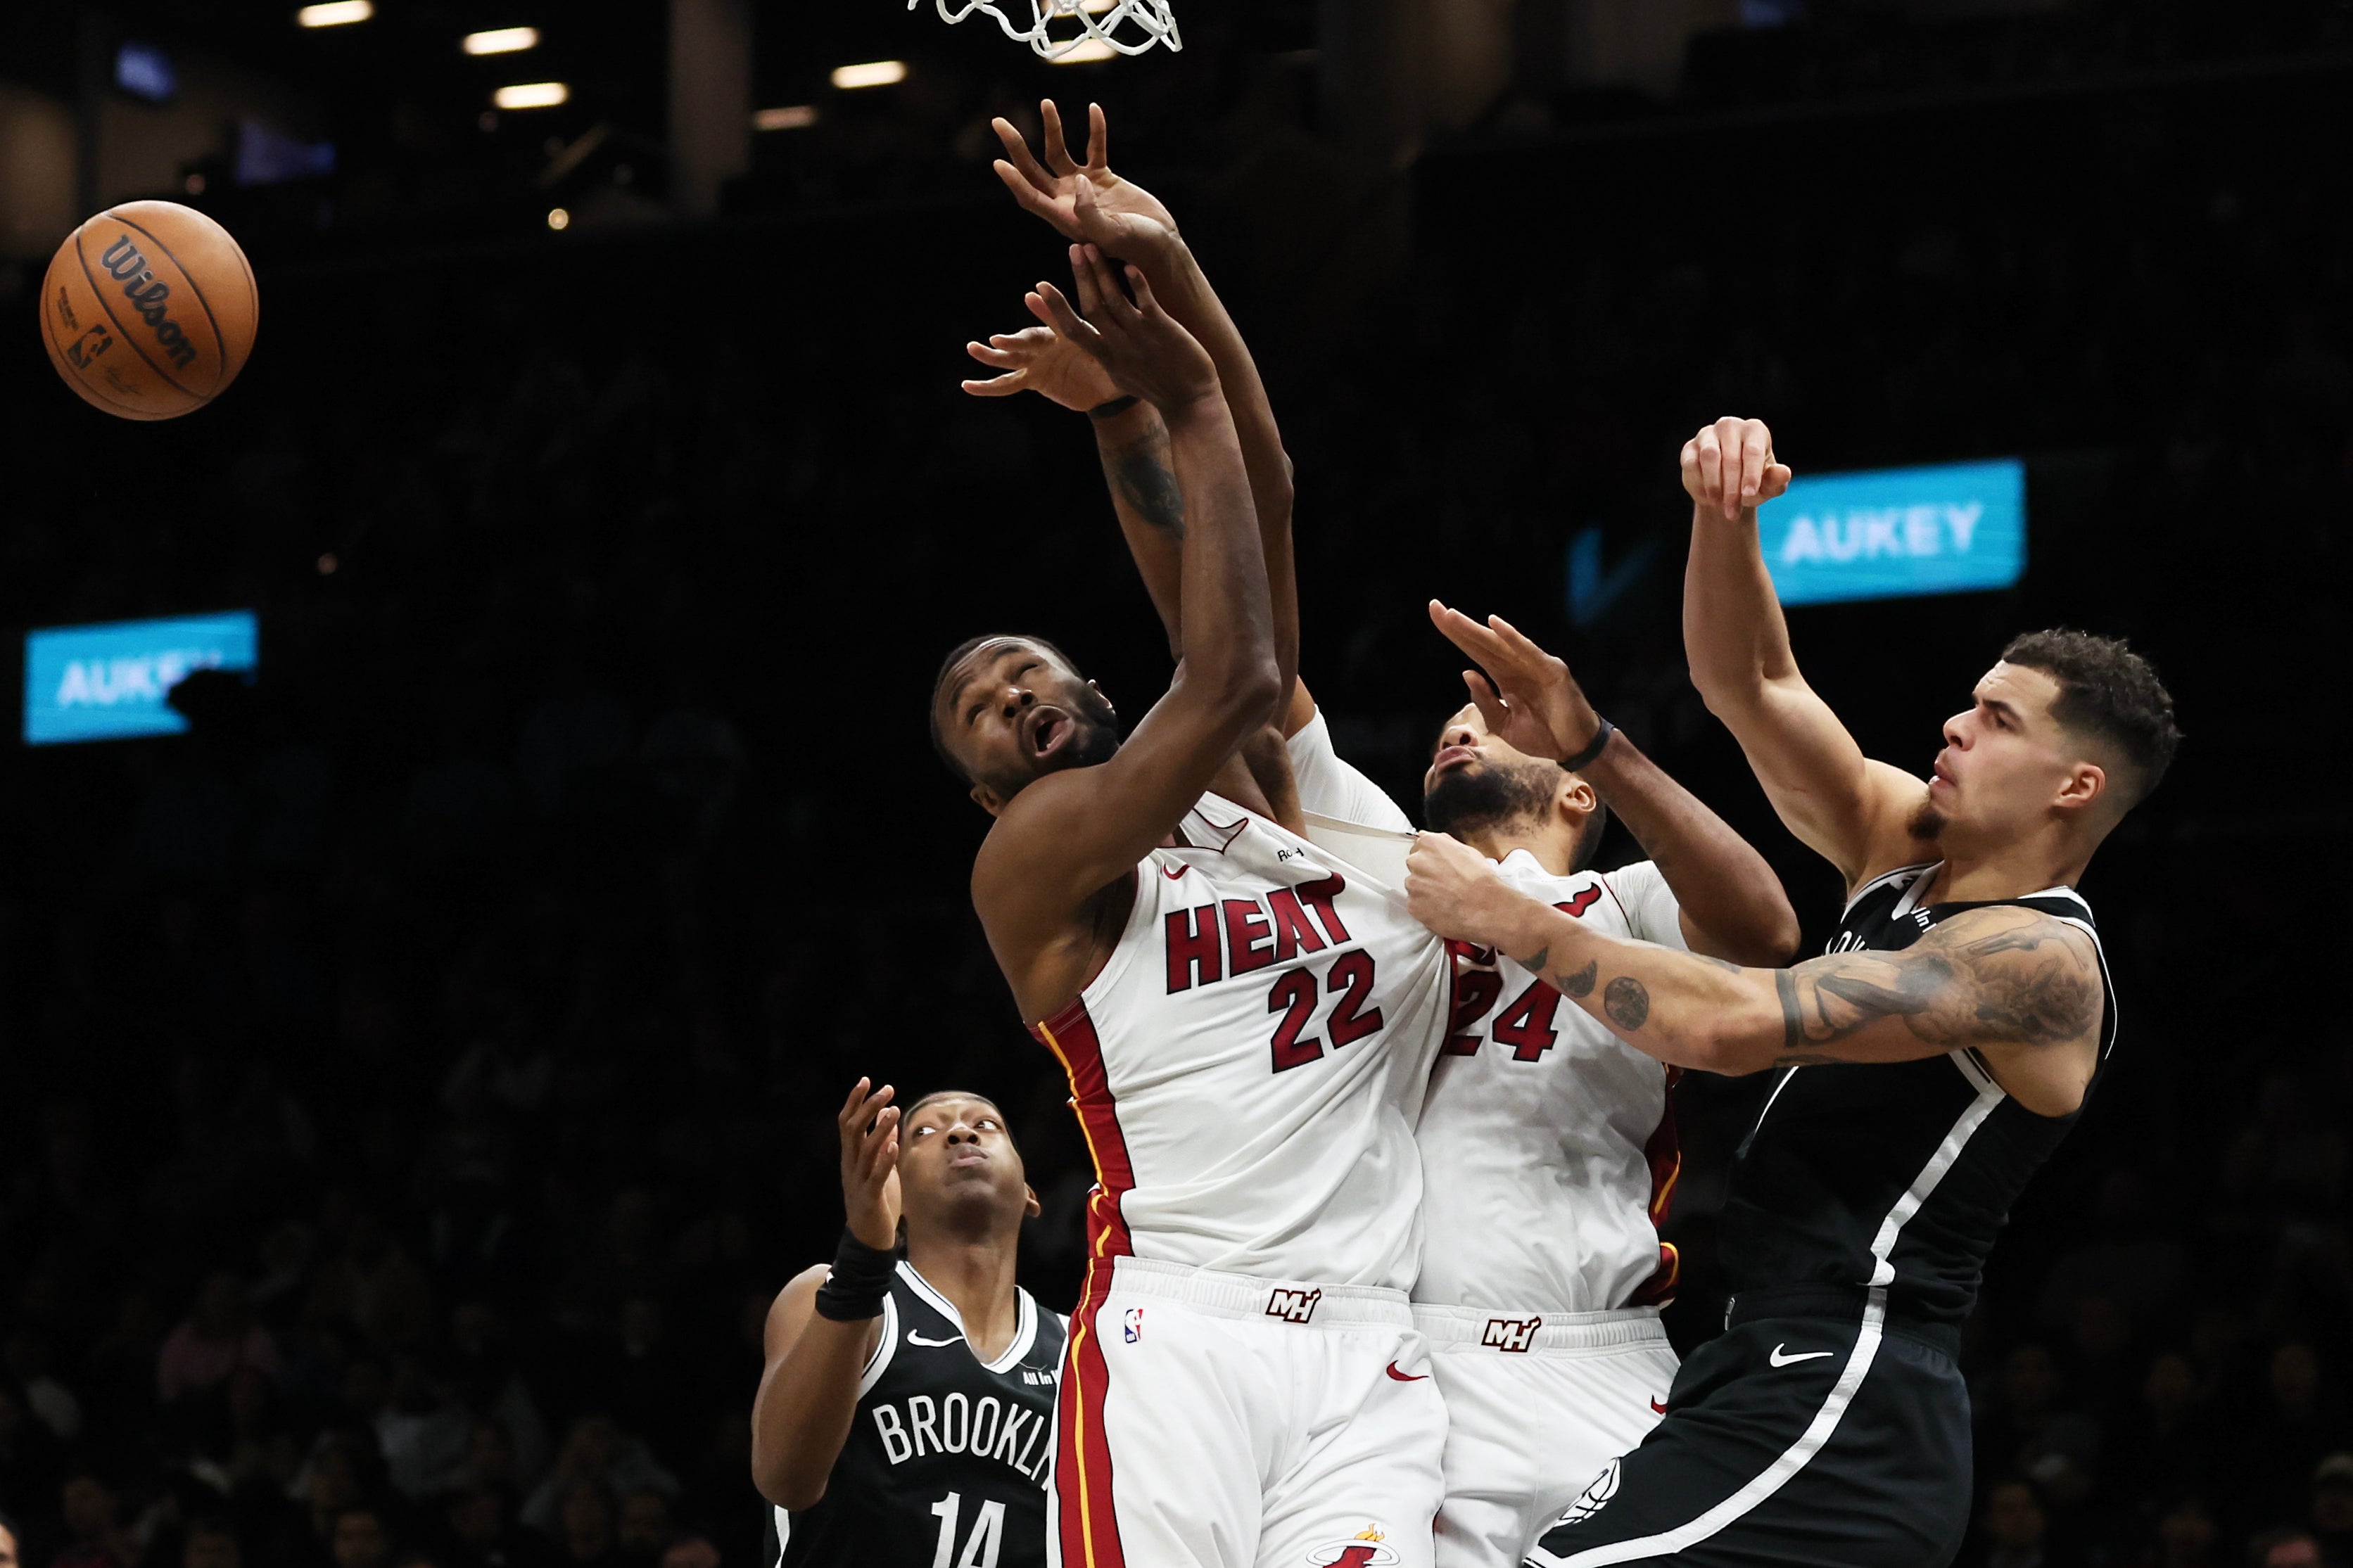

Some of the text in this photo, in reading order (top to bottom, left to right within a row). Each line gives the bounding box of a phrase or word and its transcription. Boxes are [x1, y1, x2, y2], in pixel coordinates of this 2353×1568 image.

[101, 234, 196, 369] Wilson
[1782, 501, 1981, 563] AUKEY
[1165, 872, 1351, 995] HEAT
[1268, 948, 1383, 1073] 22
[1445, 970, 1561, 1062] 24
[1023, 1372, 1039, 1385] All
[1039, 1372, 1053, 1385] In
[931, 1491, 1006, 1568] 14
